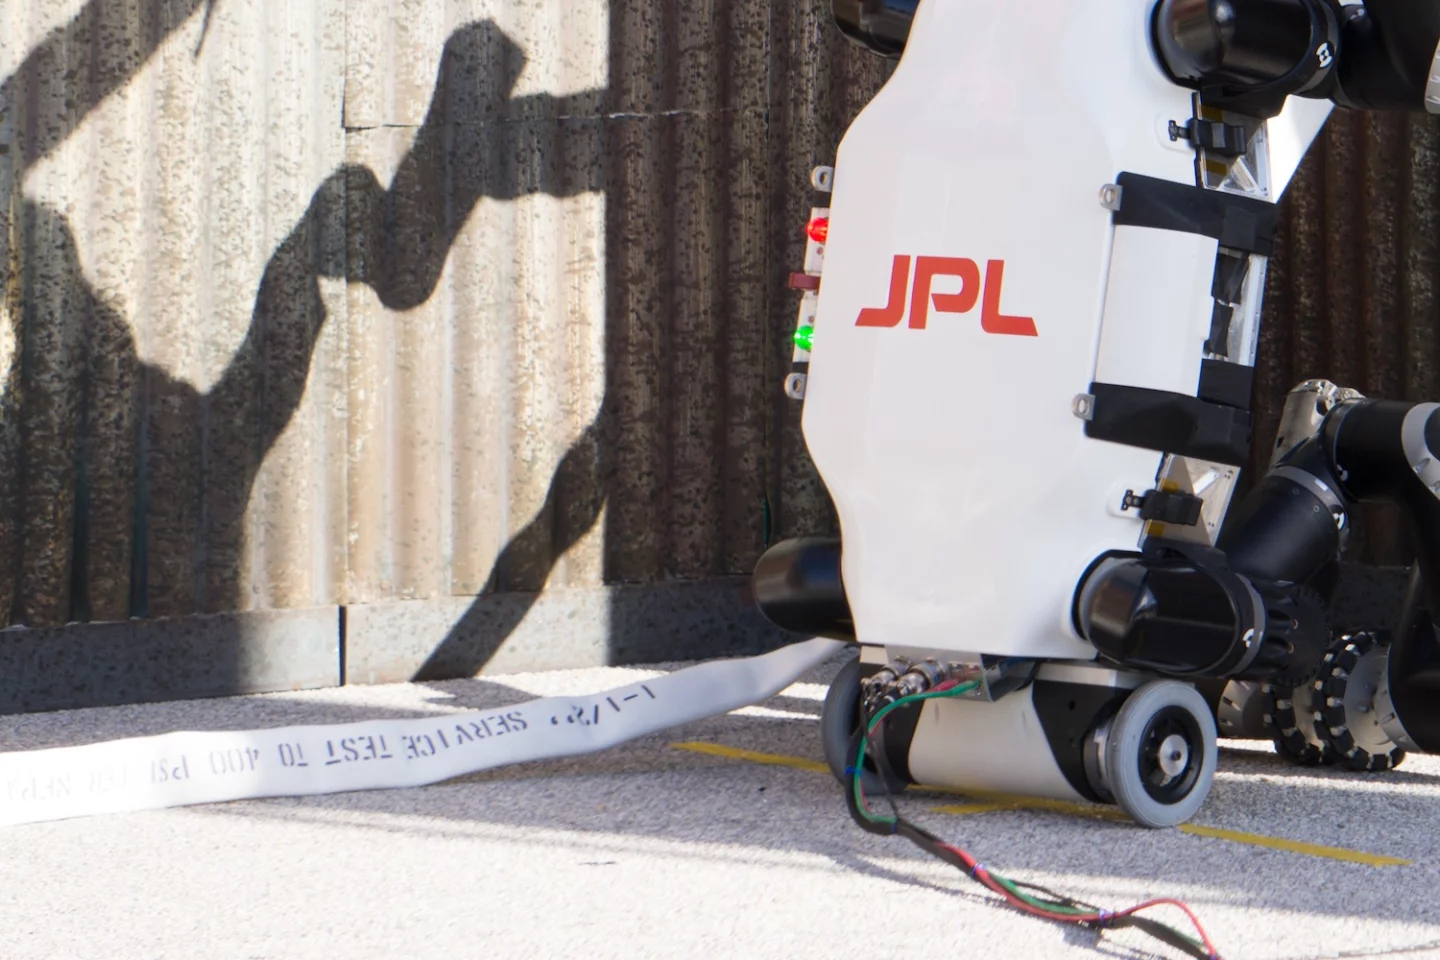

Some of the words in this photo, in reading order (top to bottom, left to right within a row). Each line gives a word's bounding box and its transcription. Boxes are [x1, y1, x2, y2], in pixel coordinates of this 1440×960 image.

[854, 254, 1039, 337] JPL
[324, 735, 393, 766] TEST
[402, 711, 528, 760] SERVICE
[208, 745, 260, 776] 400
[277, 742, 309, 768] TO
